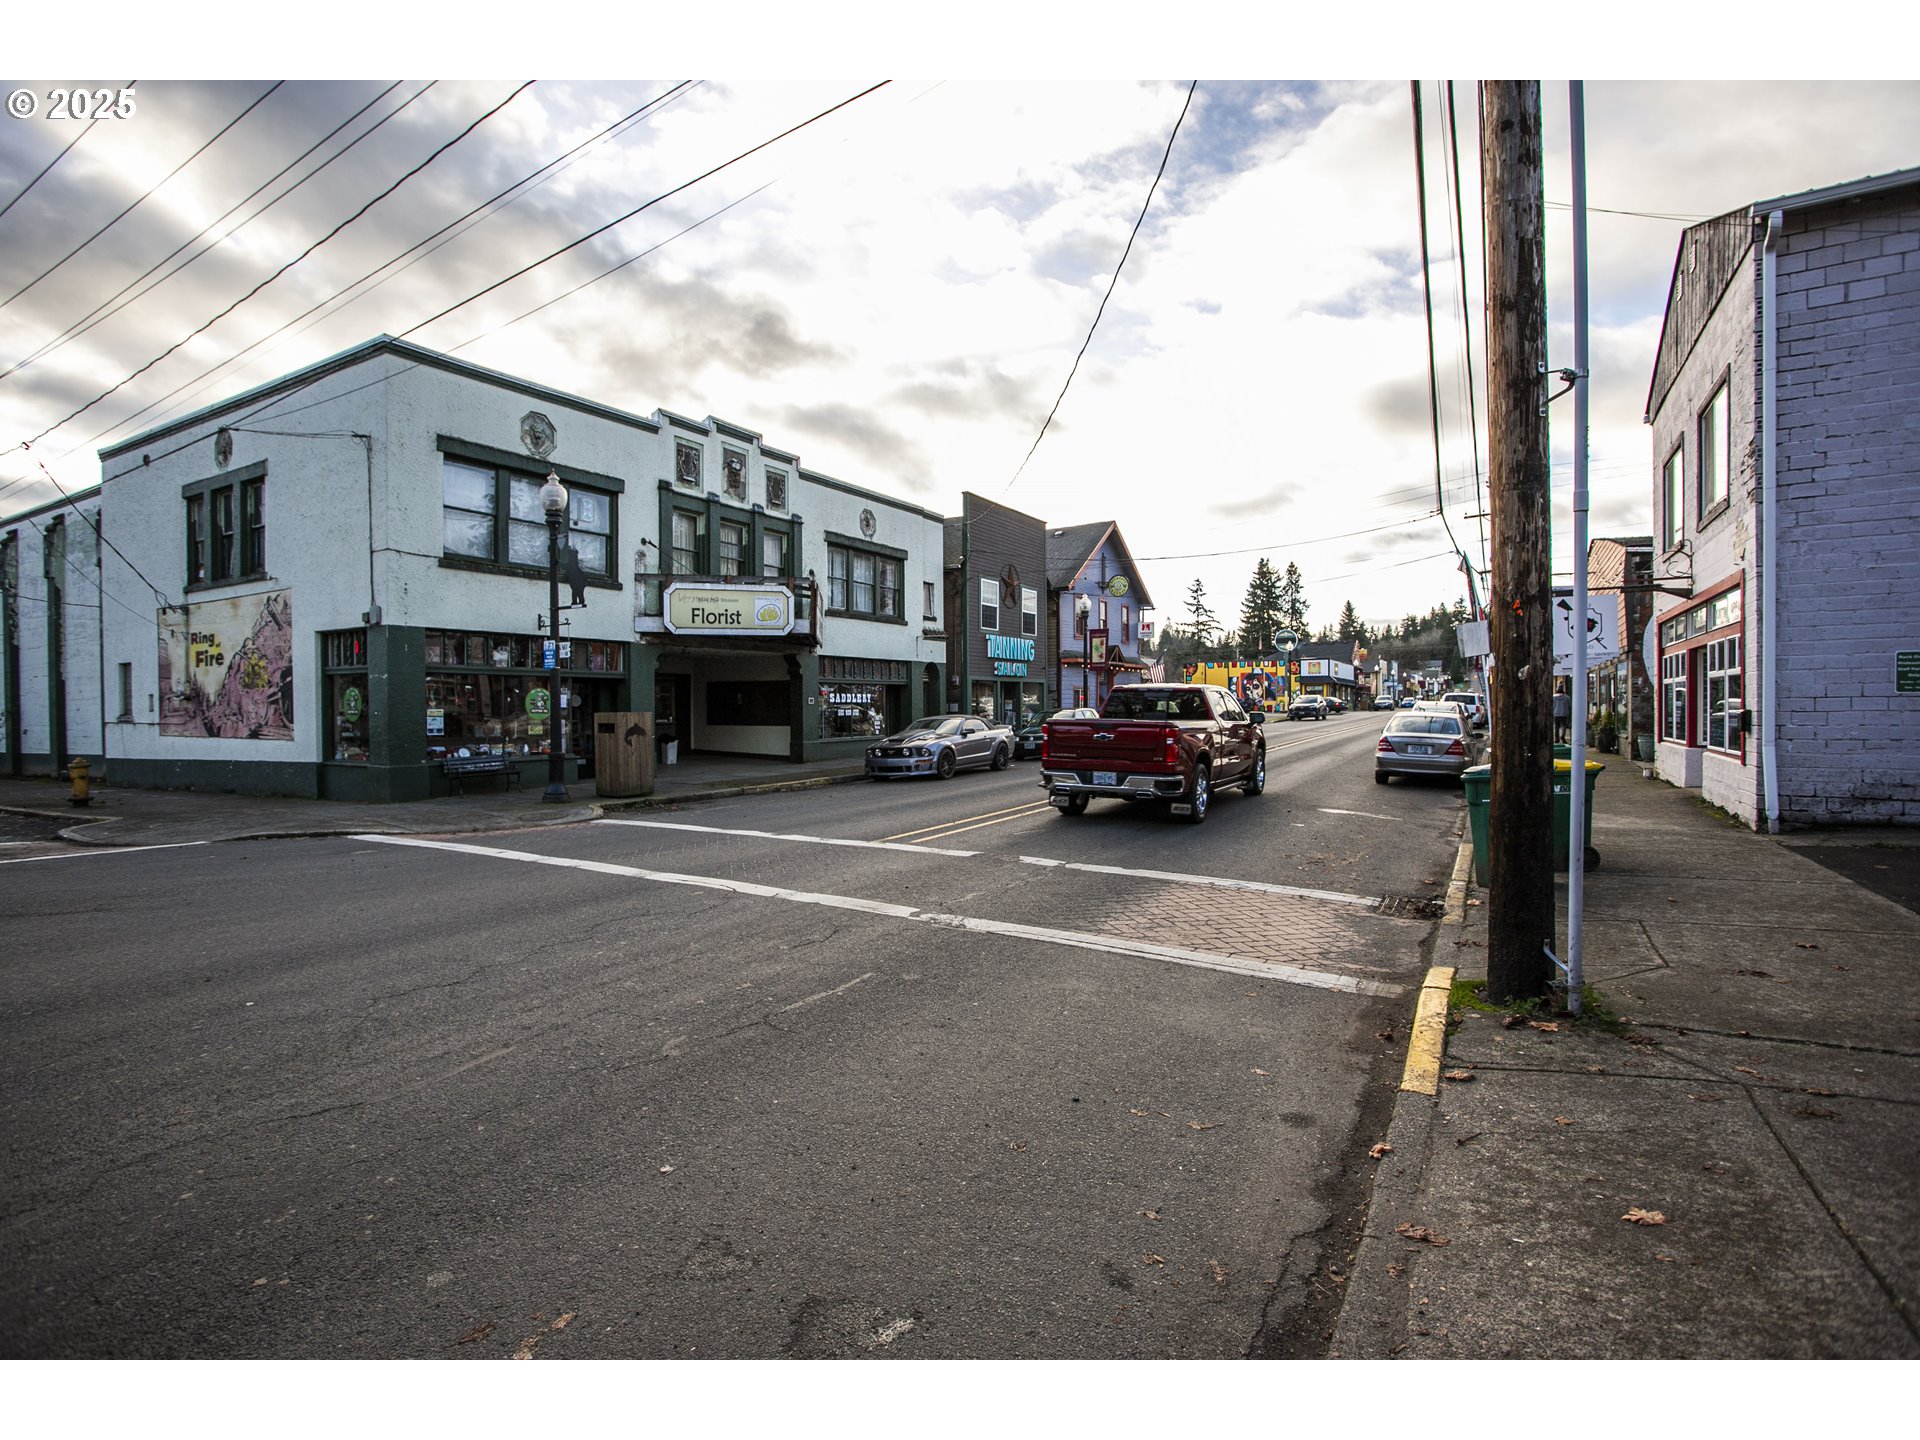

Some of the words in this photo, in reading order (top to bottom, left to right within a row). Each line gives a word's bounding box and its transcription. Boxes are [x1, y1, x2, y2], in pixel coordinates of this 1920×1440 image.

[691, 607, 742, 625] Florist
[190, 631, 215, 647] Ring
[986, 634, 1035, 661] TANNING
[195, 650, 224, 668] Fire
[994, 661, 1027, 677] SALON
[829, 693, 871, 703] SADDLERY
